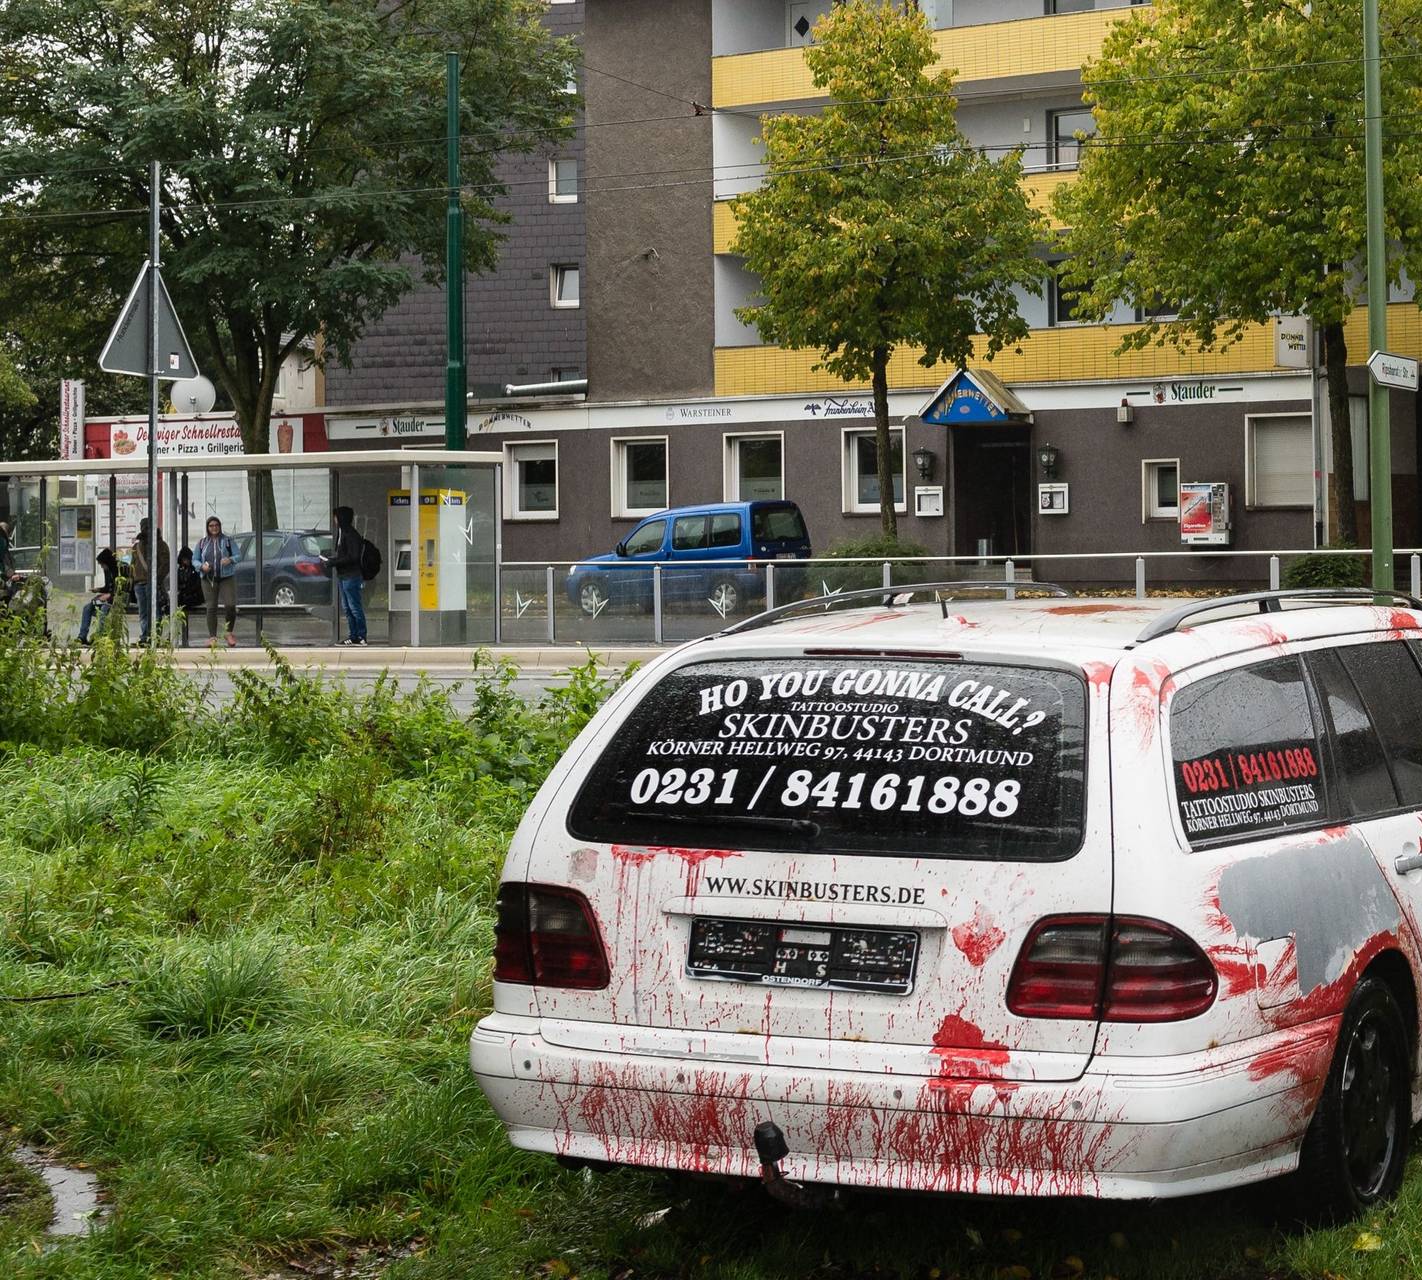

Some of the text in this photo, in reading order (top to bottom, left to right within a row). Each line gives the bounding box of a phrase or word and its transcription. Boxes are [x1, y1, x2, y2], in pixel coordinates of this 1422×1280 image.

[1171, 382, 1216, 402] Stauder
[392, 416, 425, 434] Stauder
[679, 408, 732, 417] WARSTEINER
[181, 423, 241, 441] Schnellresta
[177, 443, 199, 453] Pizza
[699, 669, 1047, 736] HO YOU GONNA CALL?
[791, 702, 899, 713] TATTOOSTUDIO
[718, 713, 972, 744] SKINBUSTERS
[646, 739, 1034, 767] KÖRNER HELLWEG 97, 44143 DORTMUND
[1182, 758, 1230, 793] 0231
[1238, 747, 1317, 785] 84161888
[630, 765, 1021, 818] 0231 / 84161888
[1181, 784, 1316, 819] TATTOOSTUDIO SKINBUSTERS
[1219, 811, 1253, 826] HELLWEG
[1280, 800, 1319, 817] DORTMUND
[706, 876, 925, 905] WW.SKINBUSTERS.DE
[761, 974, 823, 986] OSTENDORF
